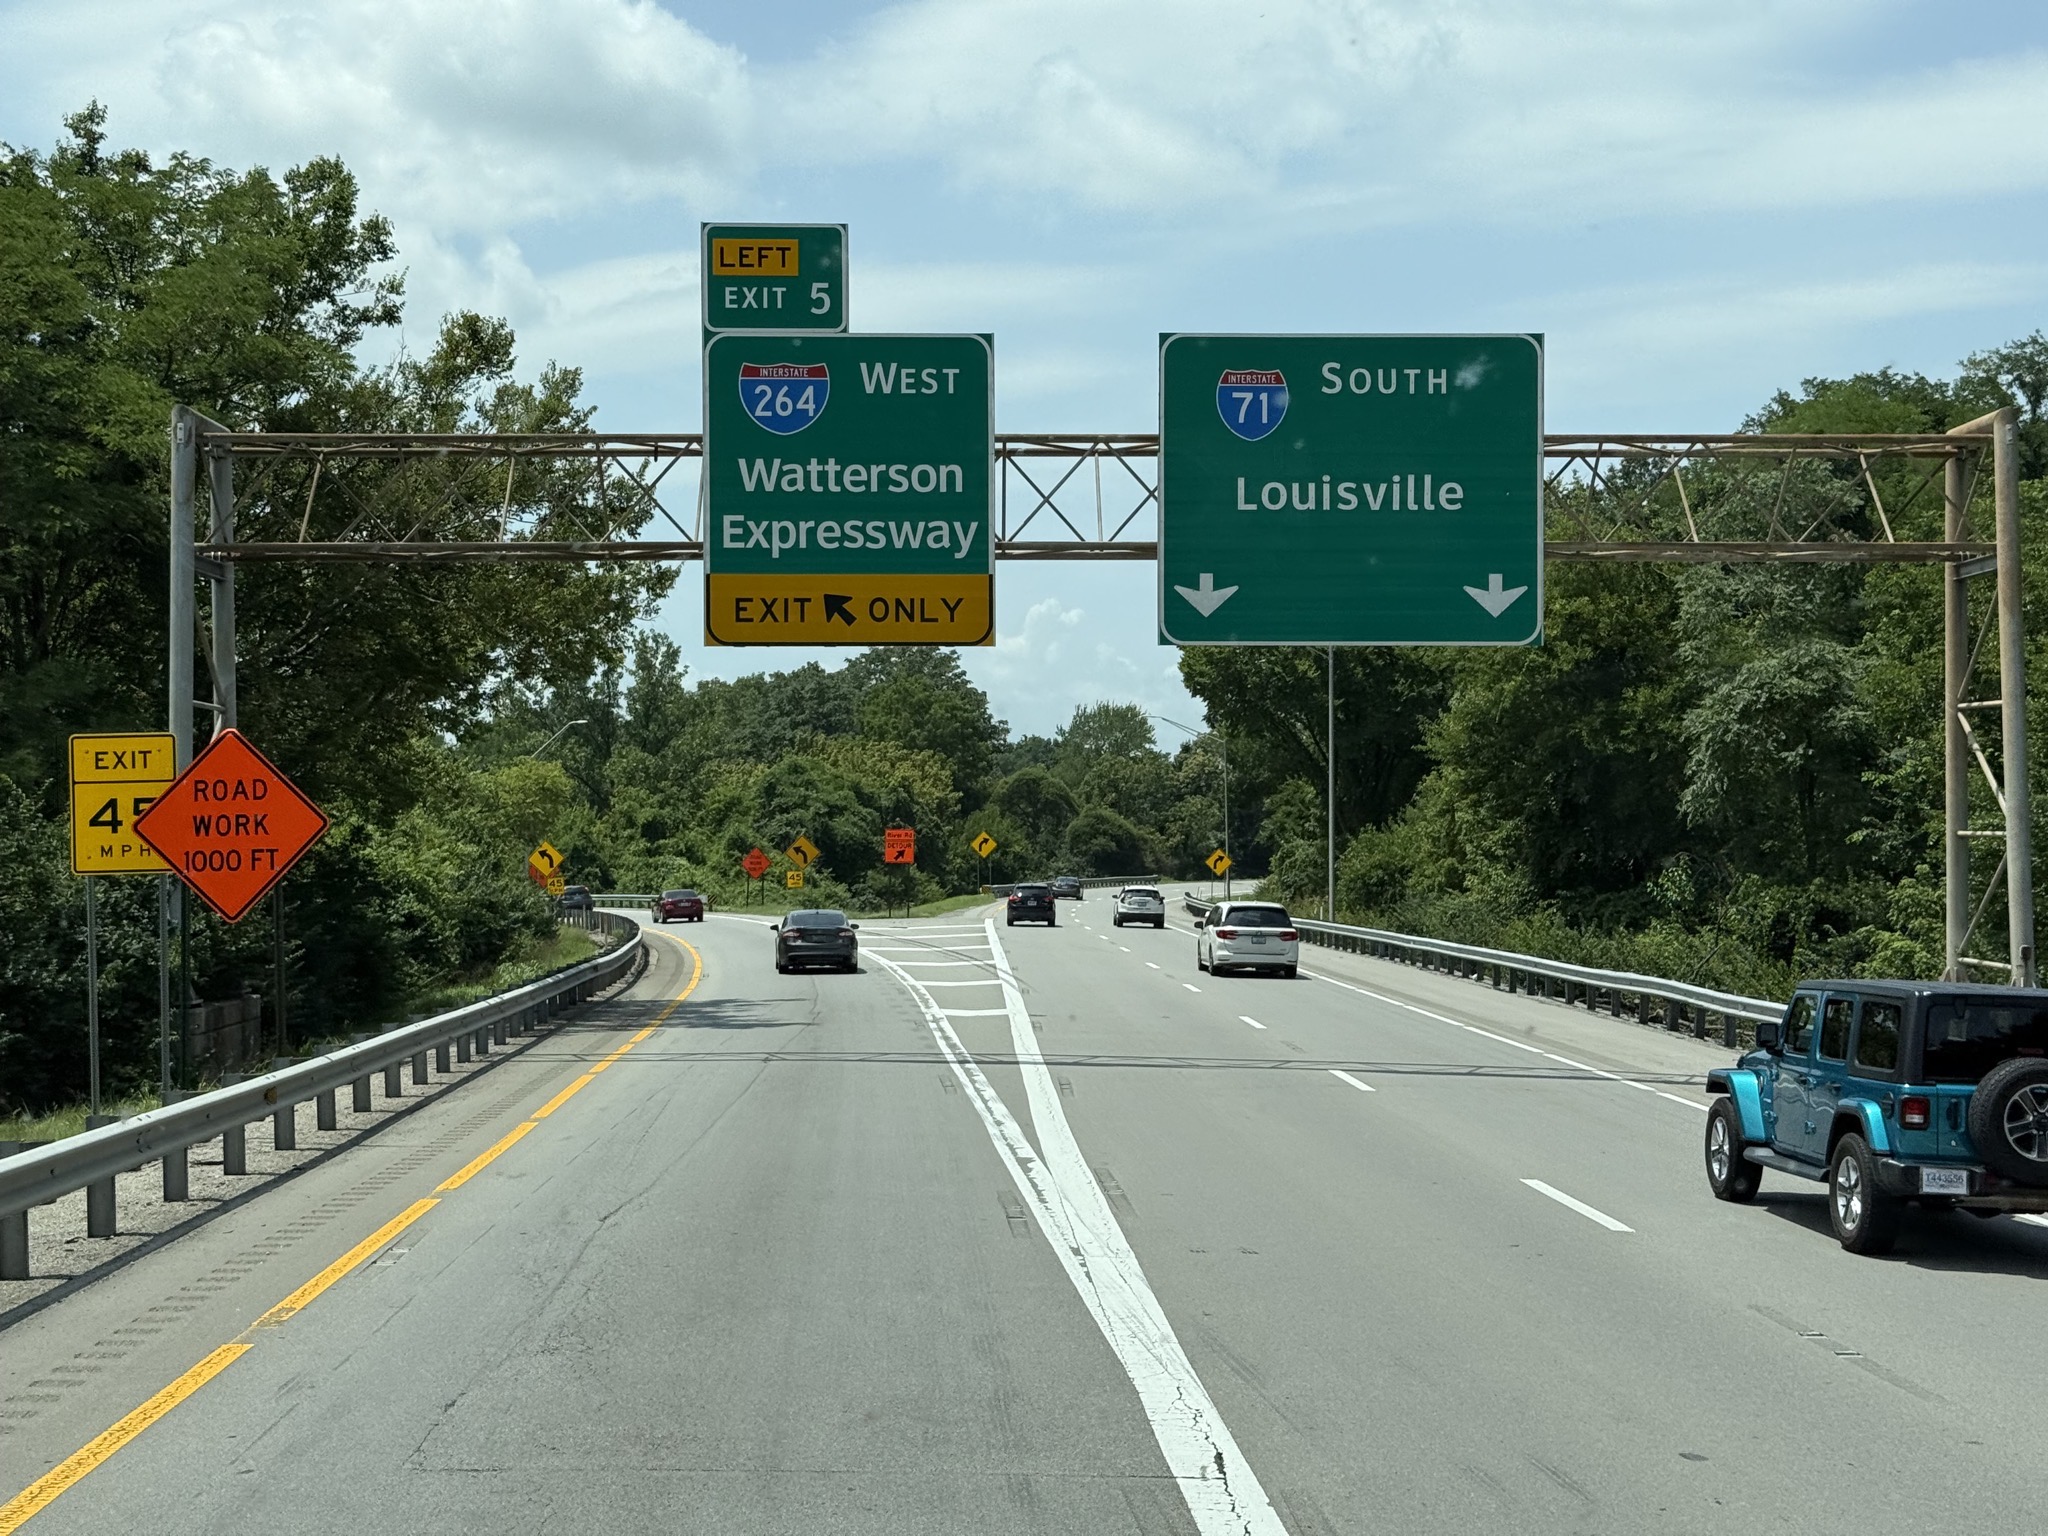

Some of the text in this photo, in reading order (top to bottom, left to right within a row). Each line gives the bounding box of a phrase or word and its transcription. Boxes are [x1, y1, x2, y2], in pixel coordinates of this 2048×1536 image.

[719, 246, 792, 268] LEFT
[724, 282, 831, 315] EXIT 5
[759, 366, 809, 378] INTERSTATE
[860, 362, 960, 394] WEST
[1227, 373, 1277, 385] INTERSTATE
[1321, 361, 1448, 395] SOUTH
[754, 385, 816, 417] 264
[1232, 391, 1269, 424] 71
[738, 457, 963, 493] Watterson
[1237, 474, 1464, 511] Louisville
[722, 514, 979, 559] Expressway
[735, 597, 964, 624] EXIT ONLY
[94, 750, 153, 770] EXIT
[193, 778, 268, 802] ROAD
[193, 814, 269, 837] WORK
[101, 845, 151, 858] MPH
[184, 848, 279, 873] 1000 FT
[549, 879, 563, 888] 45
[789, 874, 802, 882] 45
